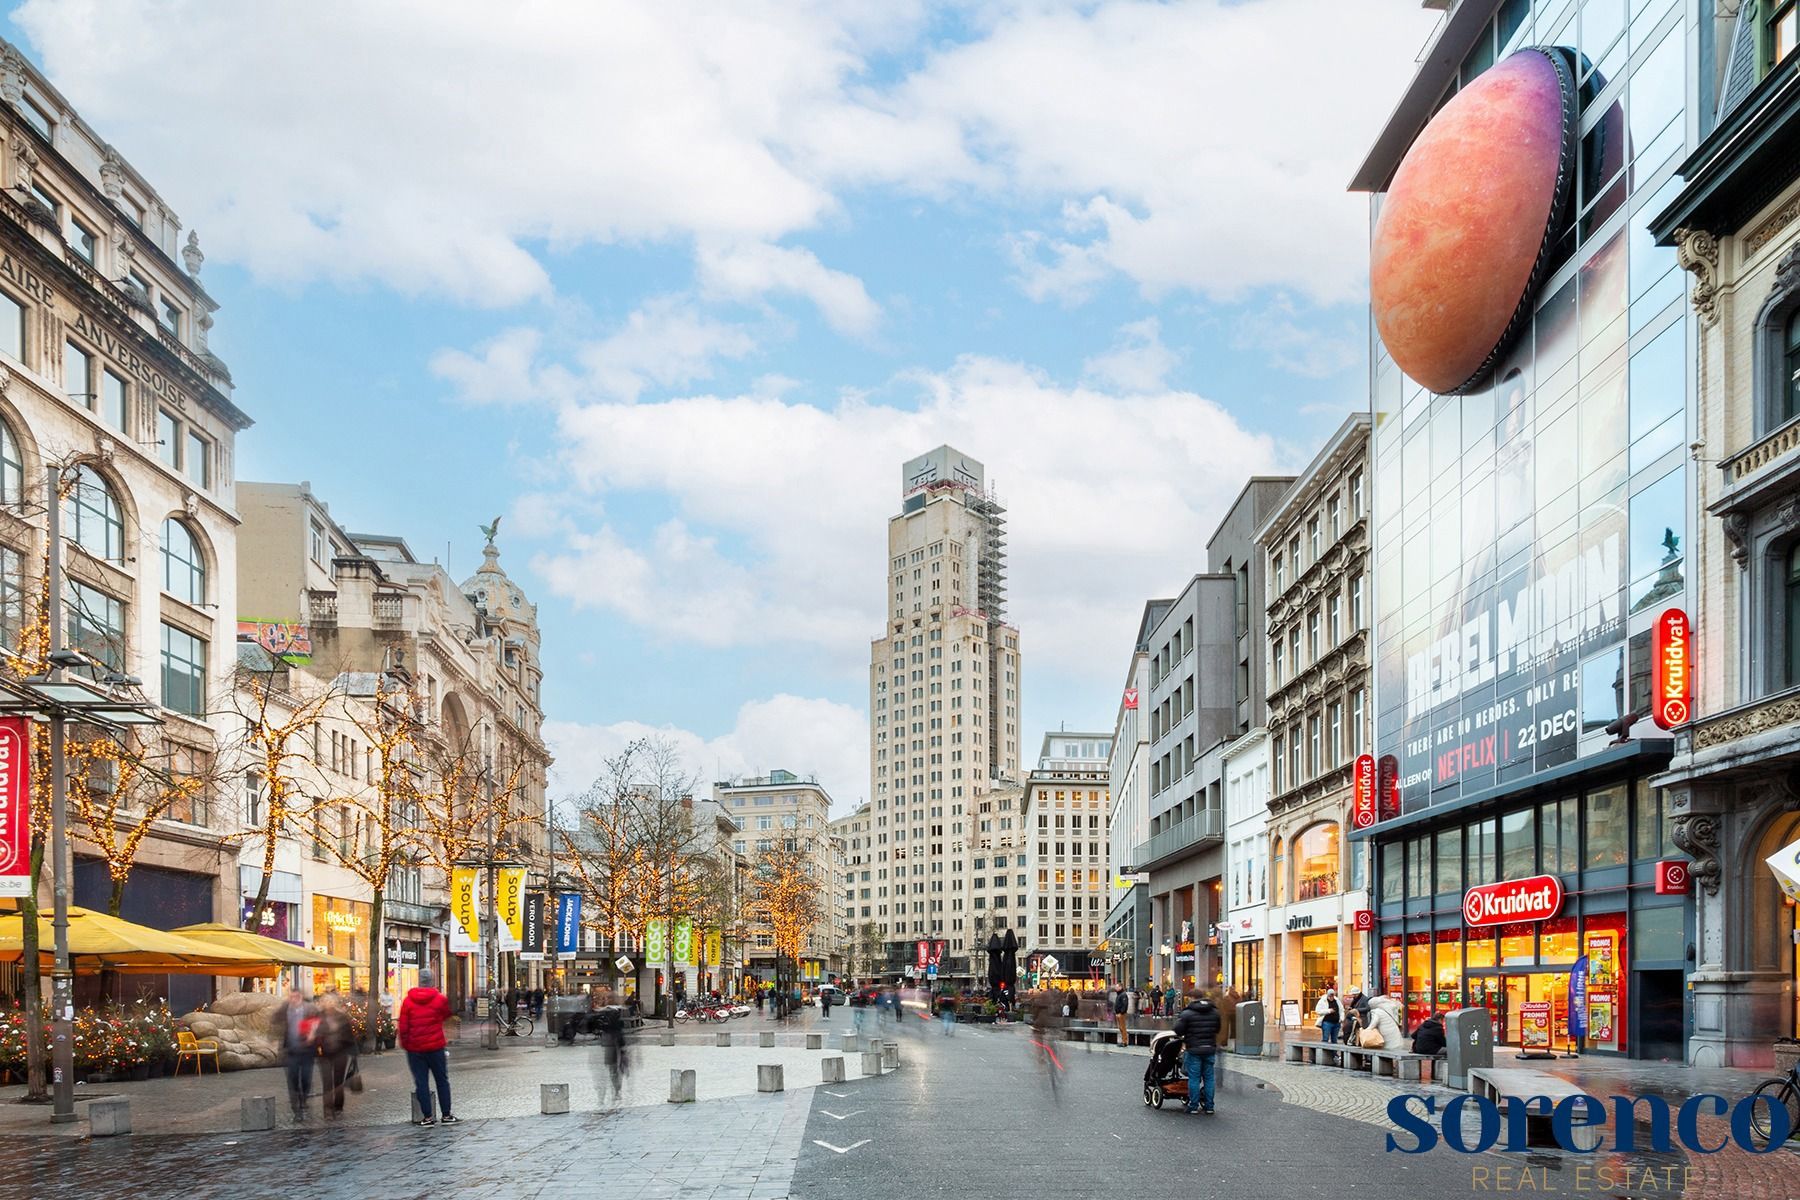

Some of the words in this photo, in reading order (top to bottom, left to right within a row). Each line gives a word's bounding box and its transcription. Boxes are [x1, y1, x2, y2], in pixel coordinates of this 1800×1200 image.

[1, 254, 55, 309] AIRE
[75, 312, 187, 411] ANVERSOISE
[1408, 610, 1495, 720] REBEL
[1497, 532, 1619, 675] MOON
[1665, 616, 1684, 698] Kruidvat
[1407, 734, 1433, 758] THERE
[1437, 726, 1454, 746] ARE
[1458, 717, 1471, 736] NO
[1475, 698, 1520, 729] HEROES.
[1526, 679, 1557, 707] ONLY
[1517, 723, 1538, 749] 22
[1540, 708, 1578, 741] DEC
[1394, 771, 1421, 790] ALLEEN
[1422, 768, 1432, 782] OP
[1437, 734, 1496, 784] NETFLIX
[1360, 760, 1372, 810] Kruidvat
[458, 884, 471, 935] Panos
[506, 877, 518, 926] Panos
[1484, 885, 1552, 916] Kruidvat
[387, 947, 417, 960] Tuprware
[1590, 938, 1610, 947] PROMO!
[1590, 994, 1610, 1002] PROMO!
